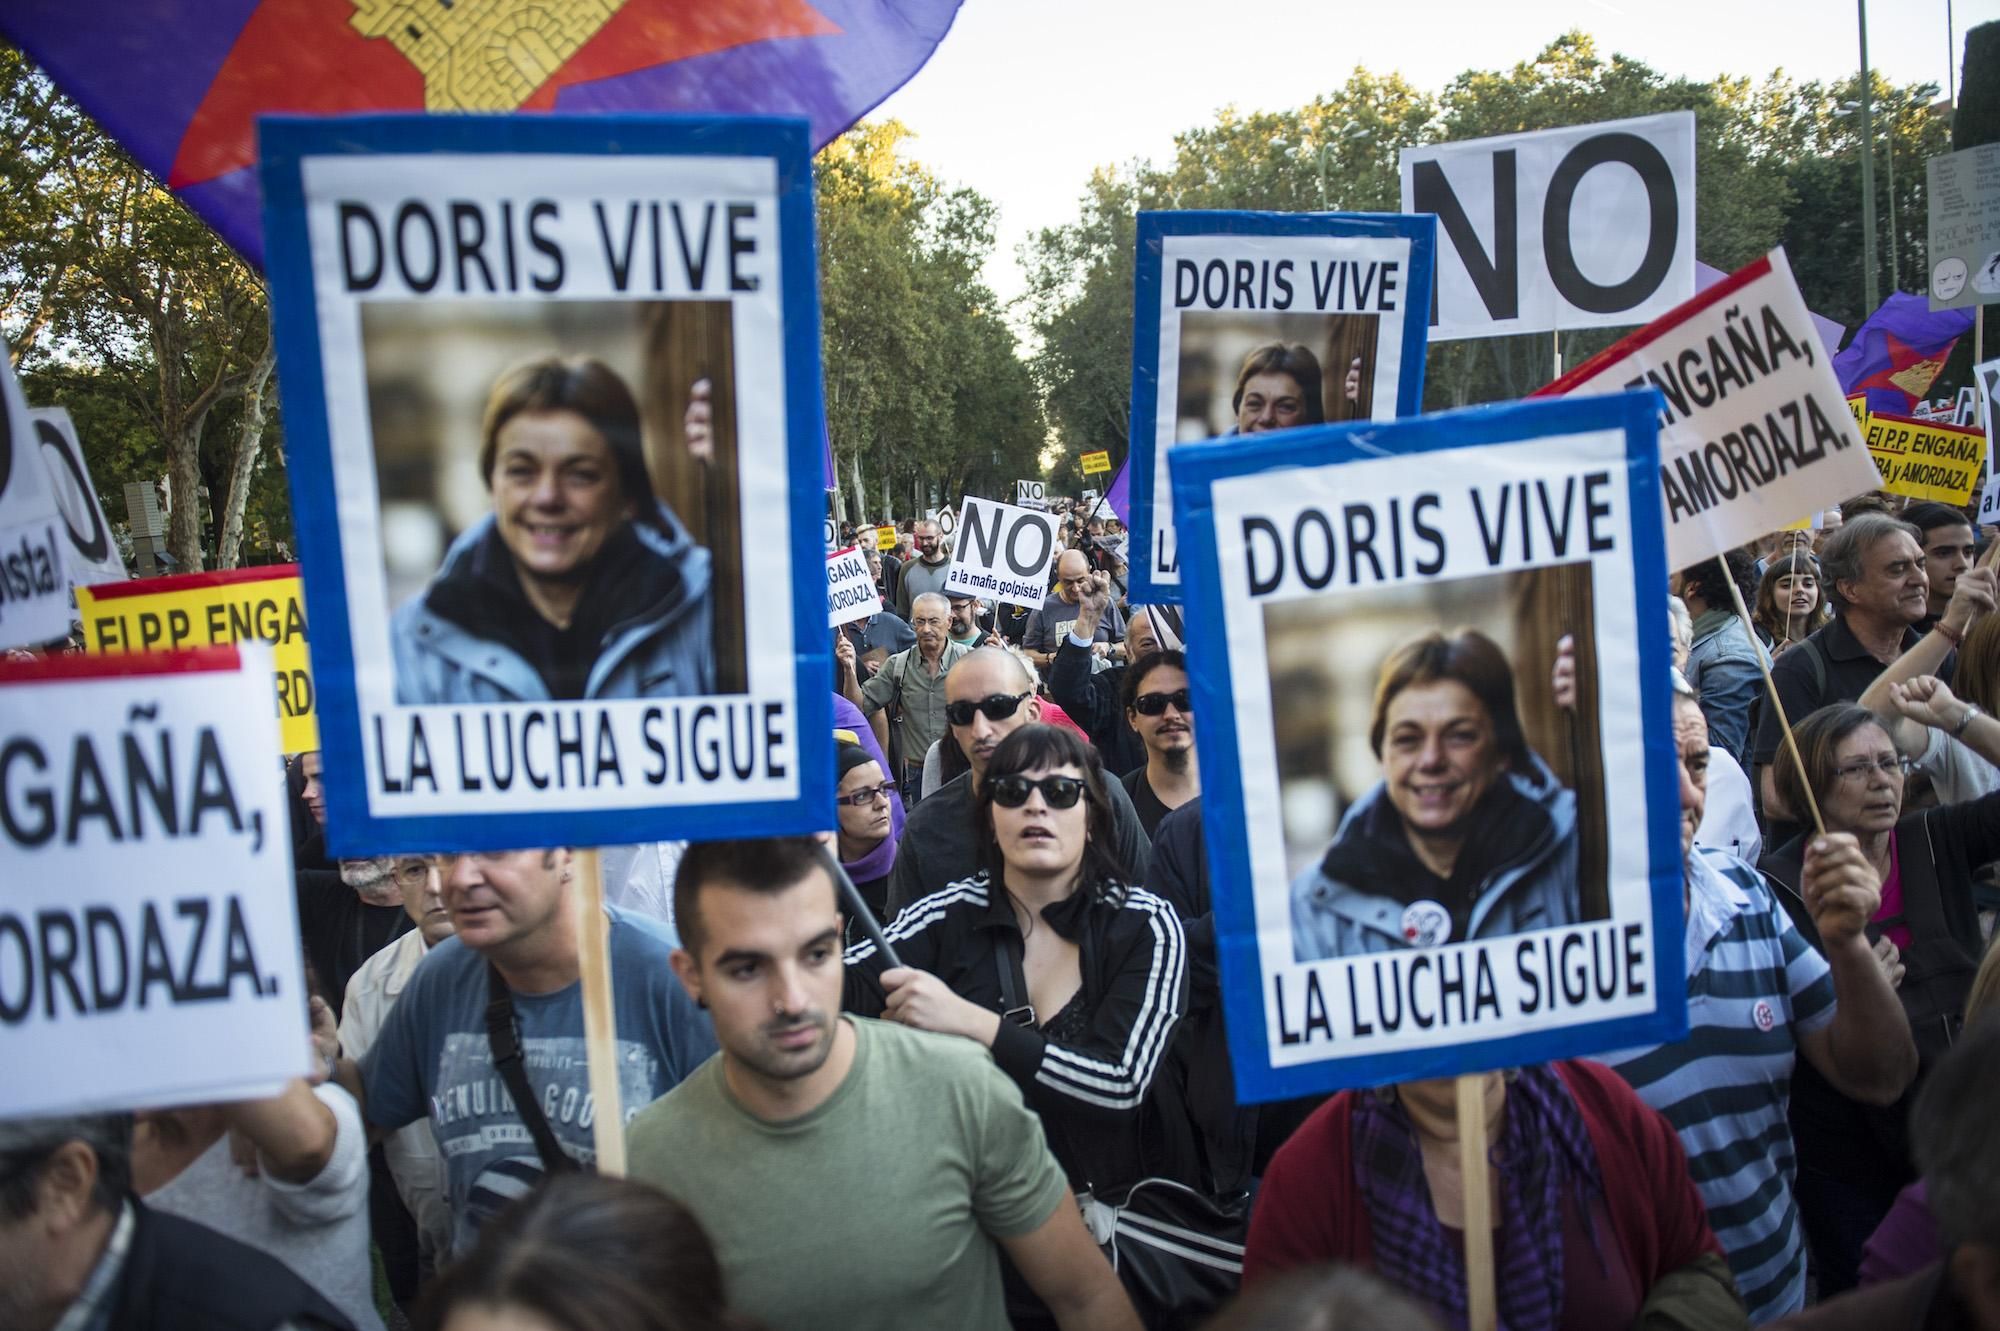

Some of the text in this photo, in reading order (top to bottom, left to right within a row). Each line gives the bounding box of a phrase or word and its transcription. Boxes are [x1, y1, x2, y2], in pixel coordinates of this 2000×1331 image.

[338, 199, 761, 294] DORIS VIVE
[1413, 132, 1678, 326] NO
[1175, 258, 1399, 311] DORIS VIVE
[1660, 393, 1851, 524] AMORDAZA.
[1889, 465, 1901, 484] y
[1900, 462, 1969, 492] AMORDAZA.
[1912, 433, 1980, 467] ENGAÑA,
[1019, 482, 1044, 500] NO
[956, 502, 1052, 577] NO
[1242, 470, 1614, 597] DORIS VIVE
[826, 557, 867, 586] GAÑA,
[950, 569, 1042, 600] a la mafia golpista!
[373, 702, 786, 794] LA LUCHA SIGUE
[1275, 923, 1646, 1045] LA LUCHA SIGUE
